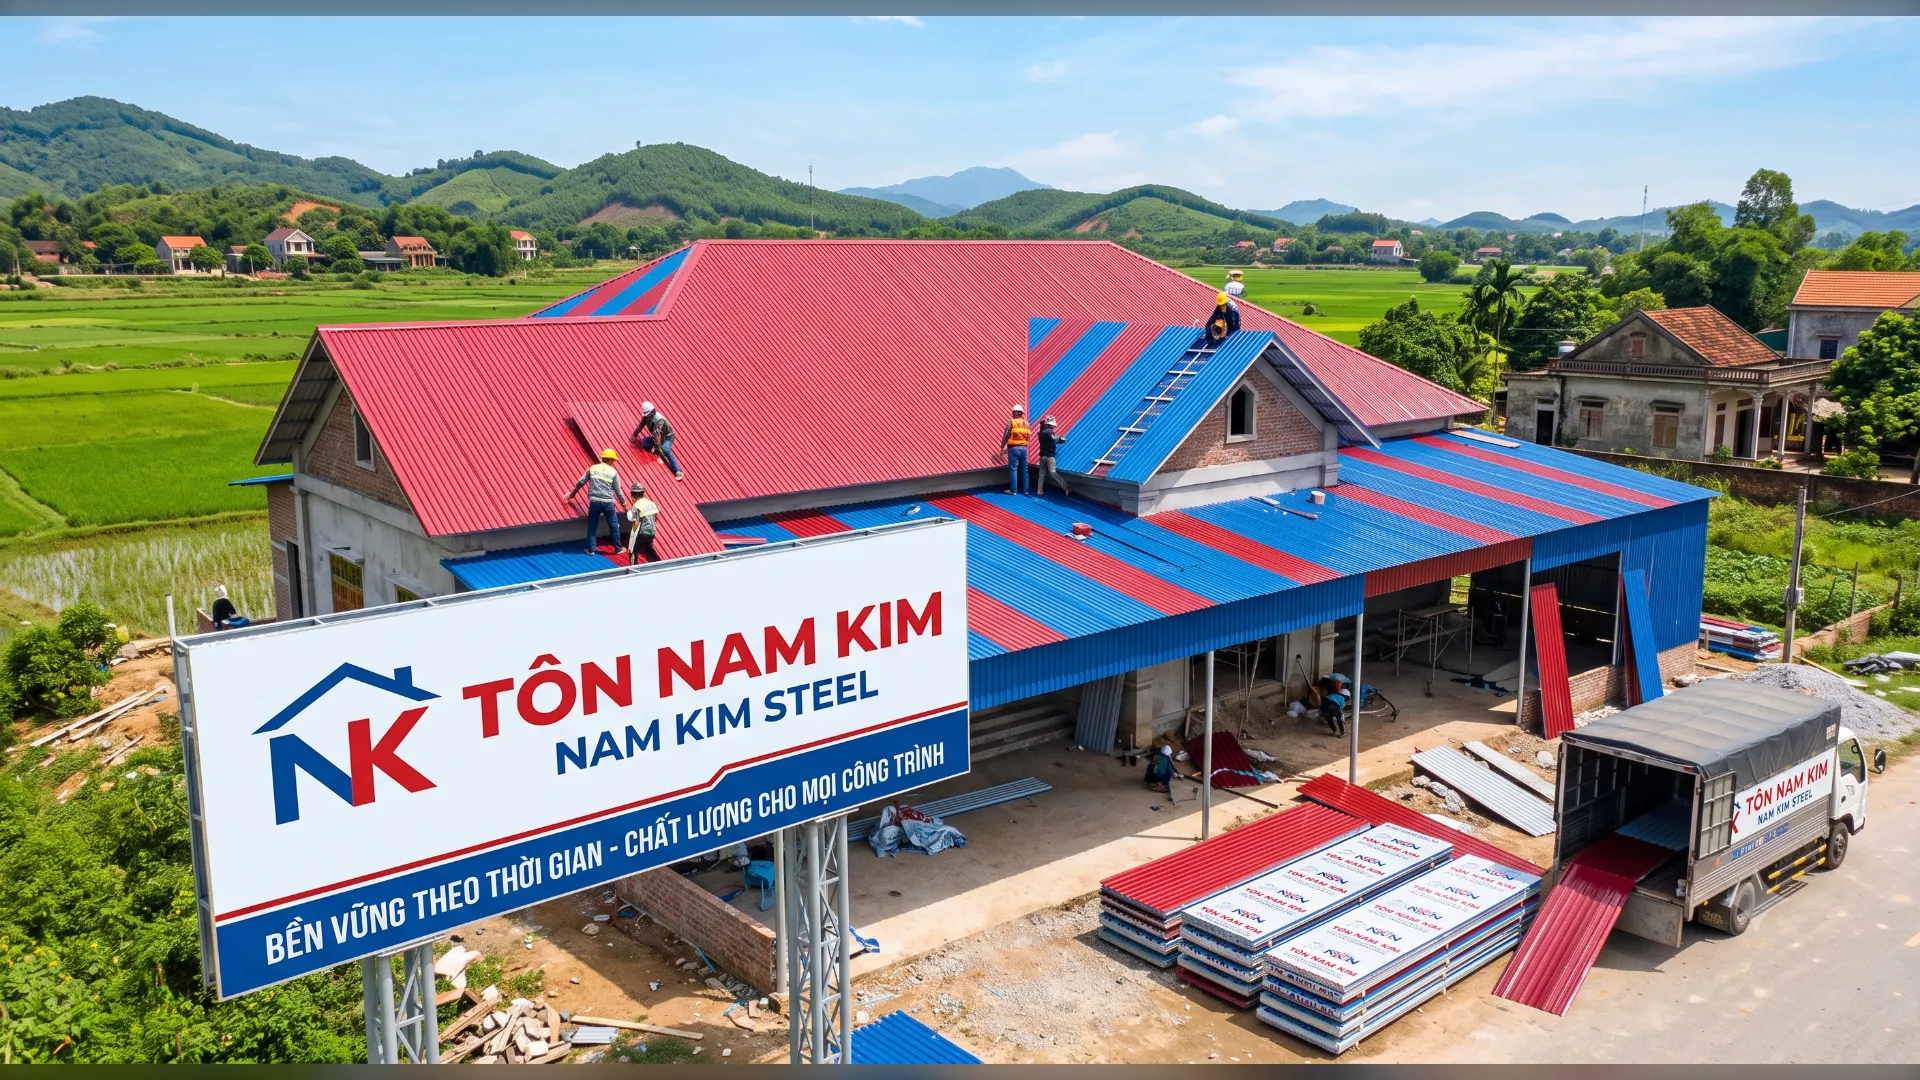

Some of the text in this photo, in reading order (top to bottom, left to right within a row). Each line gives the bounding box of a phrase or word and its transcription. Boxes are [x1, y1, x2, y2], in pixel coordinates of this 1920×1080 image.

[462, 592, 942, 739] TÔN NAM KIM
[556, 671, 878, 774] NAM KIM STEEL
[1746, 759, 1828, 815] TÔN NAM KIM
[1757, 789, 1813, 826] NAM KIM STEEL
[266, 916, 323, 964] BỀN
[331, 898, 405, 944] VỮNG
[413, 877, 479, 919] THEO
[486, 855, 541, 897] THỜI
[550, 841, 602, 880] GIAN
[625, 811, 680, 856] CHẤT
[688, 798, 751, 840] LƯỢNG
[759, 785, 796, 818] CHO
[803, 773, 837, 806] MỌI
[843, 759, 888, 793] CÔNG
[894, 742, 943, 776] TRÌNH
